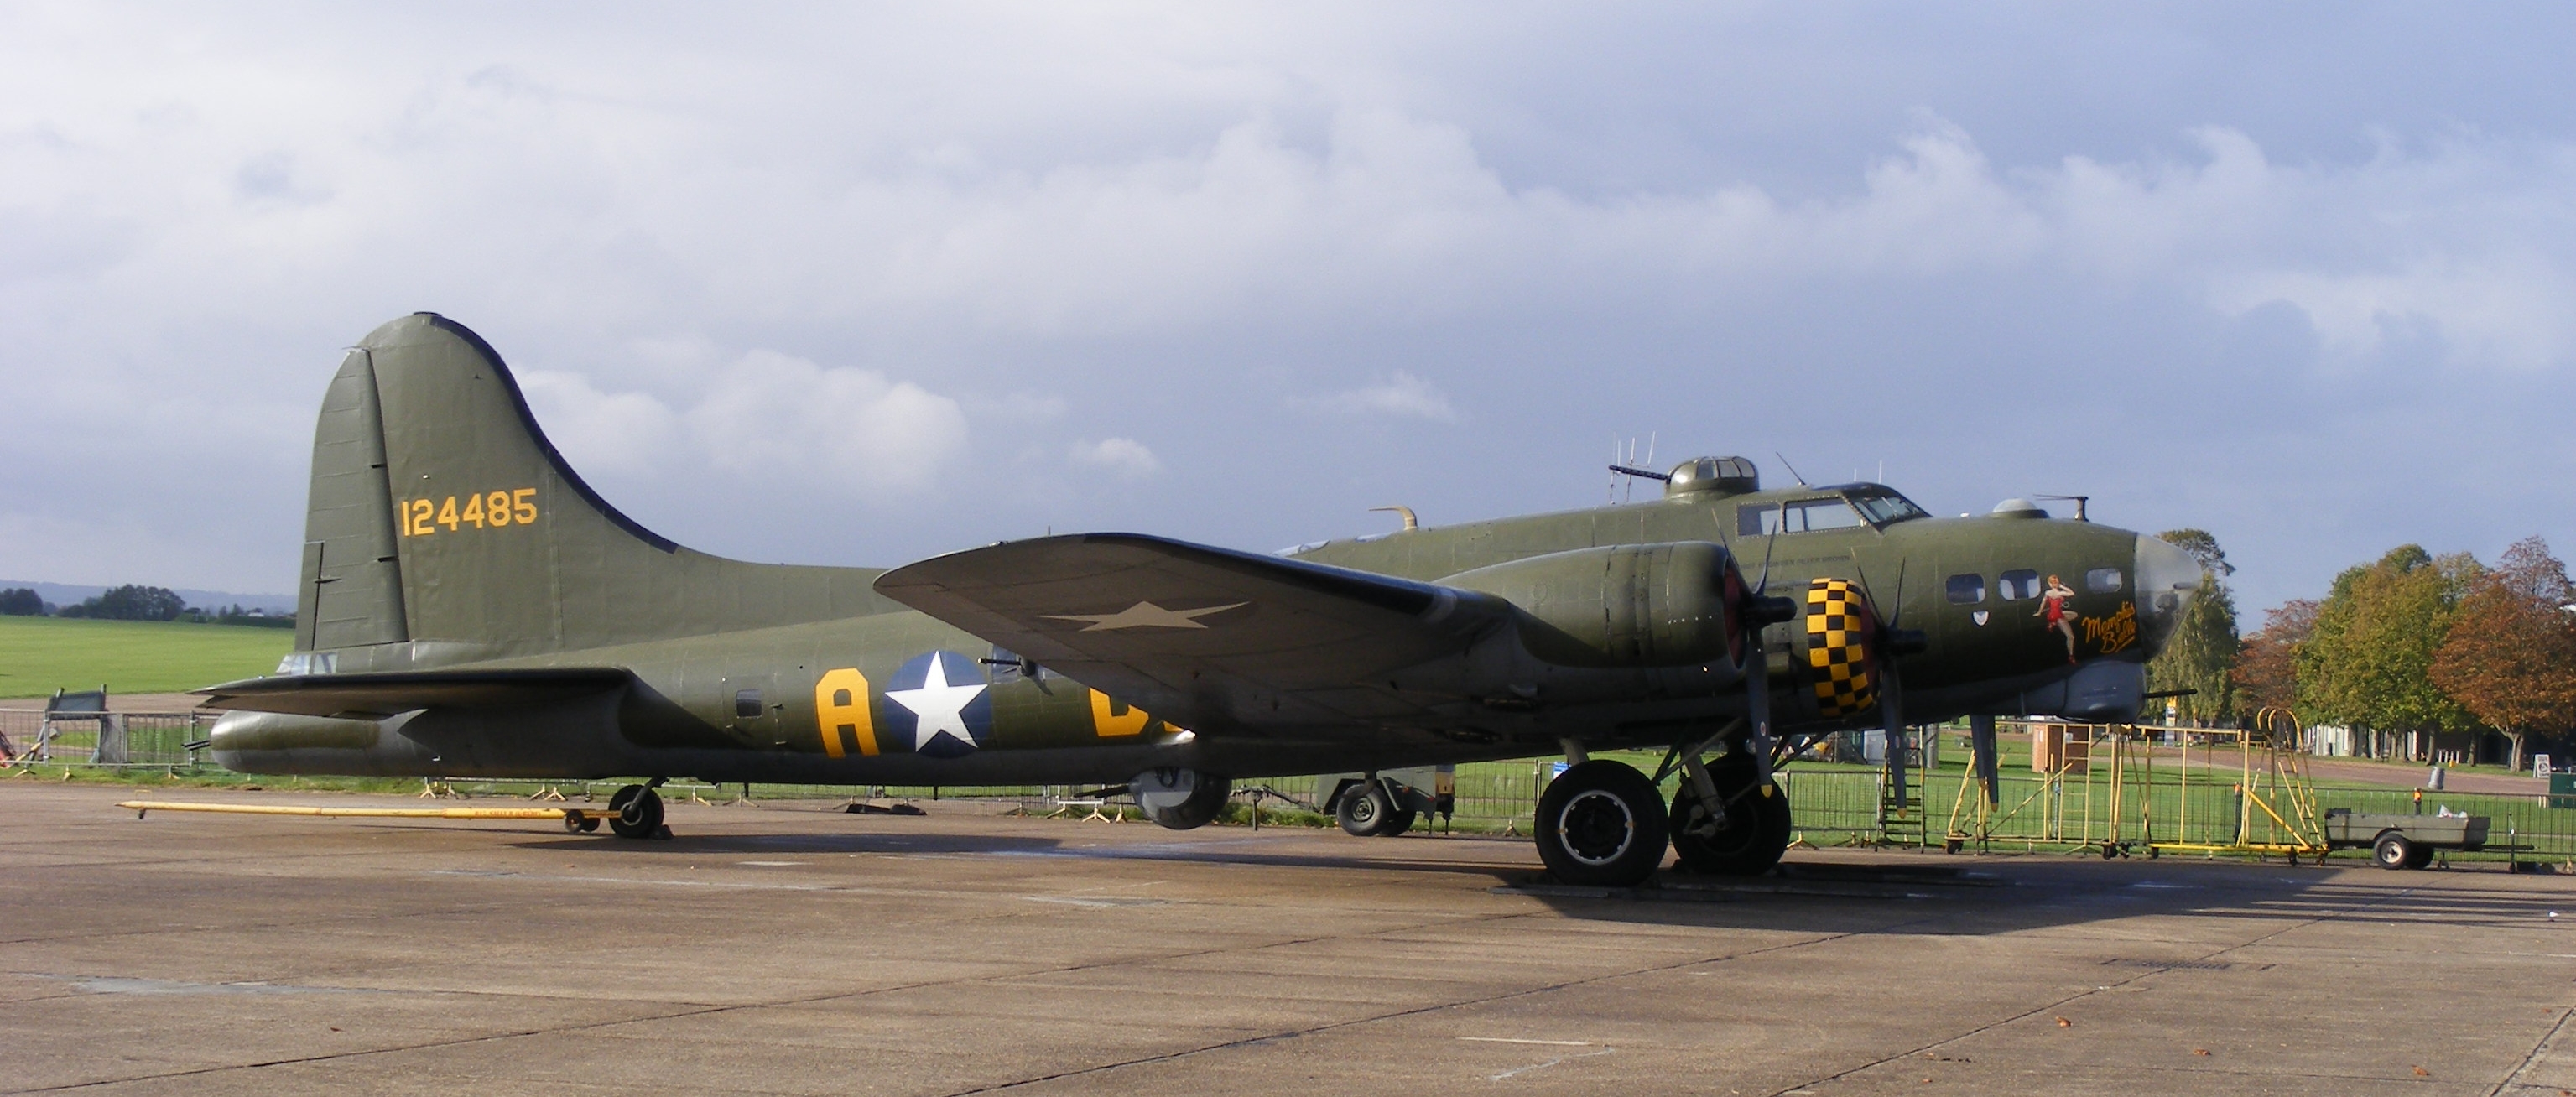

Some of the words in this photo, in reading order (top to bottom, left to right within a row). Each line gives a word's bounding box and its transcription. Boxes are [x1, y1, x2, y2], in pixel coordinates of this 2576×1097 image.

[402, 487, 538, 536] 124485
[2081, 600, 2136, 643] Memphis
[2100, 618, 2137, 653] Belle
[815, 668, 880, 758] A
